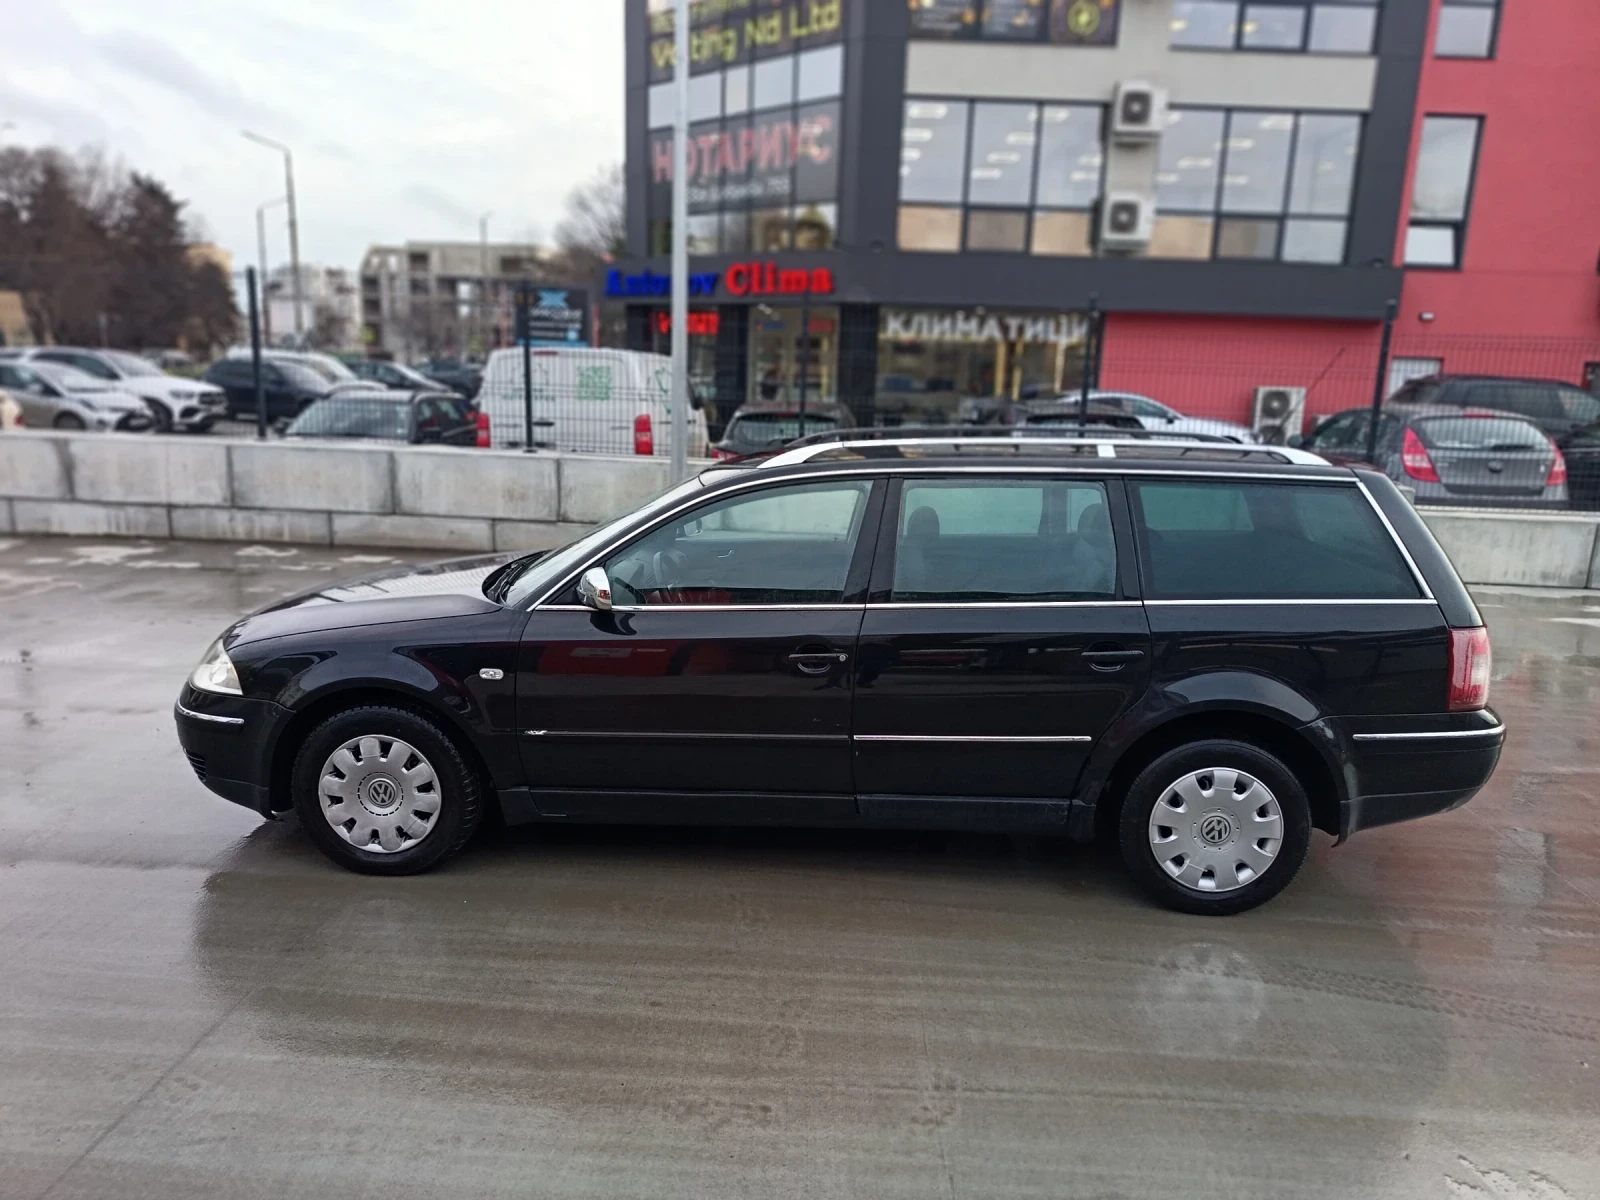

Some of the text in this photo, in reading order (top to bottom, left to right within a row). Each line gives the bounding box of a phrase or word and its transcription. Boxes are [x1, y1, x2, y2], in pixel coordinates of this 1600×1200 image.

[789, 0, 841, 37] Ltd
[725, 261, 833, 295] Clima
[886, 312, 1090, 346] КЛИМАТИЦИ
